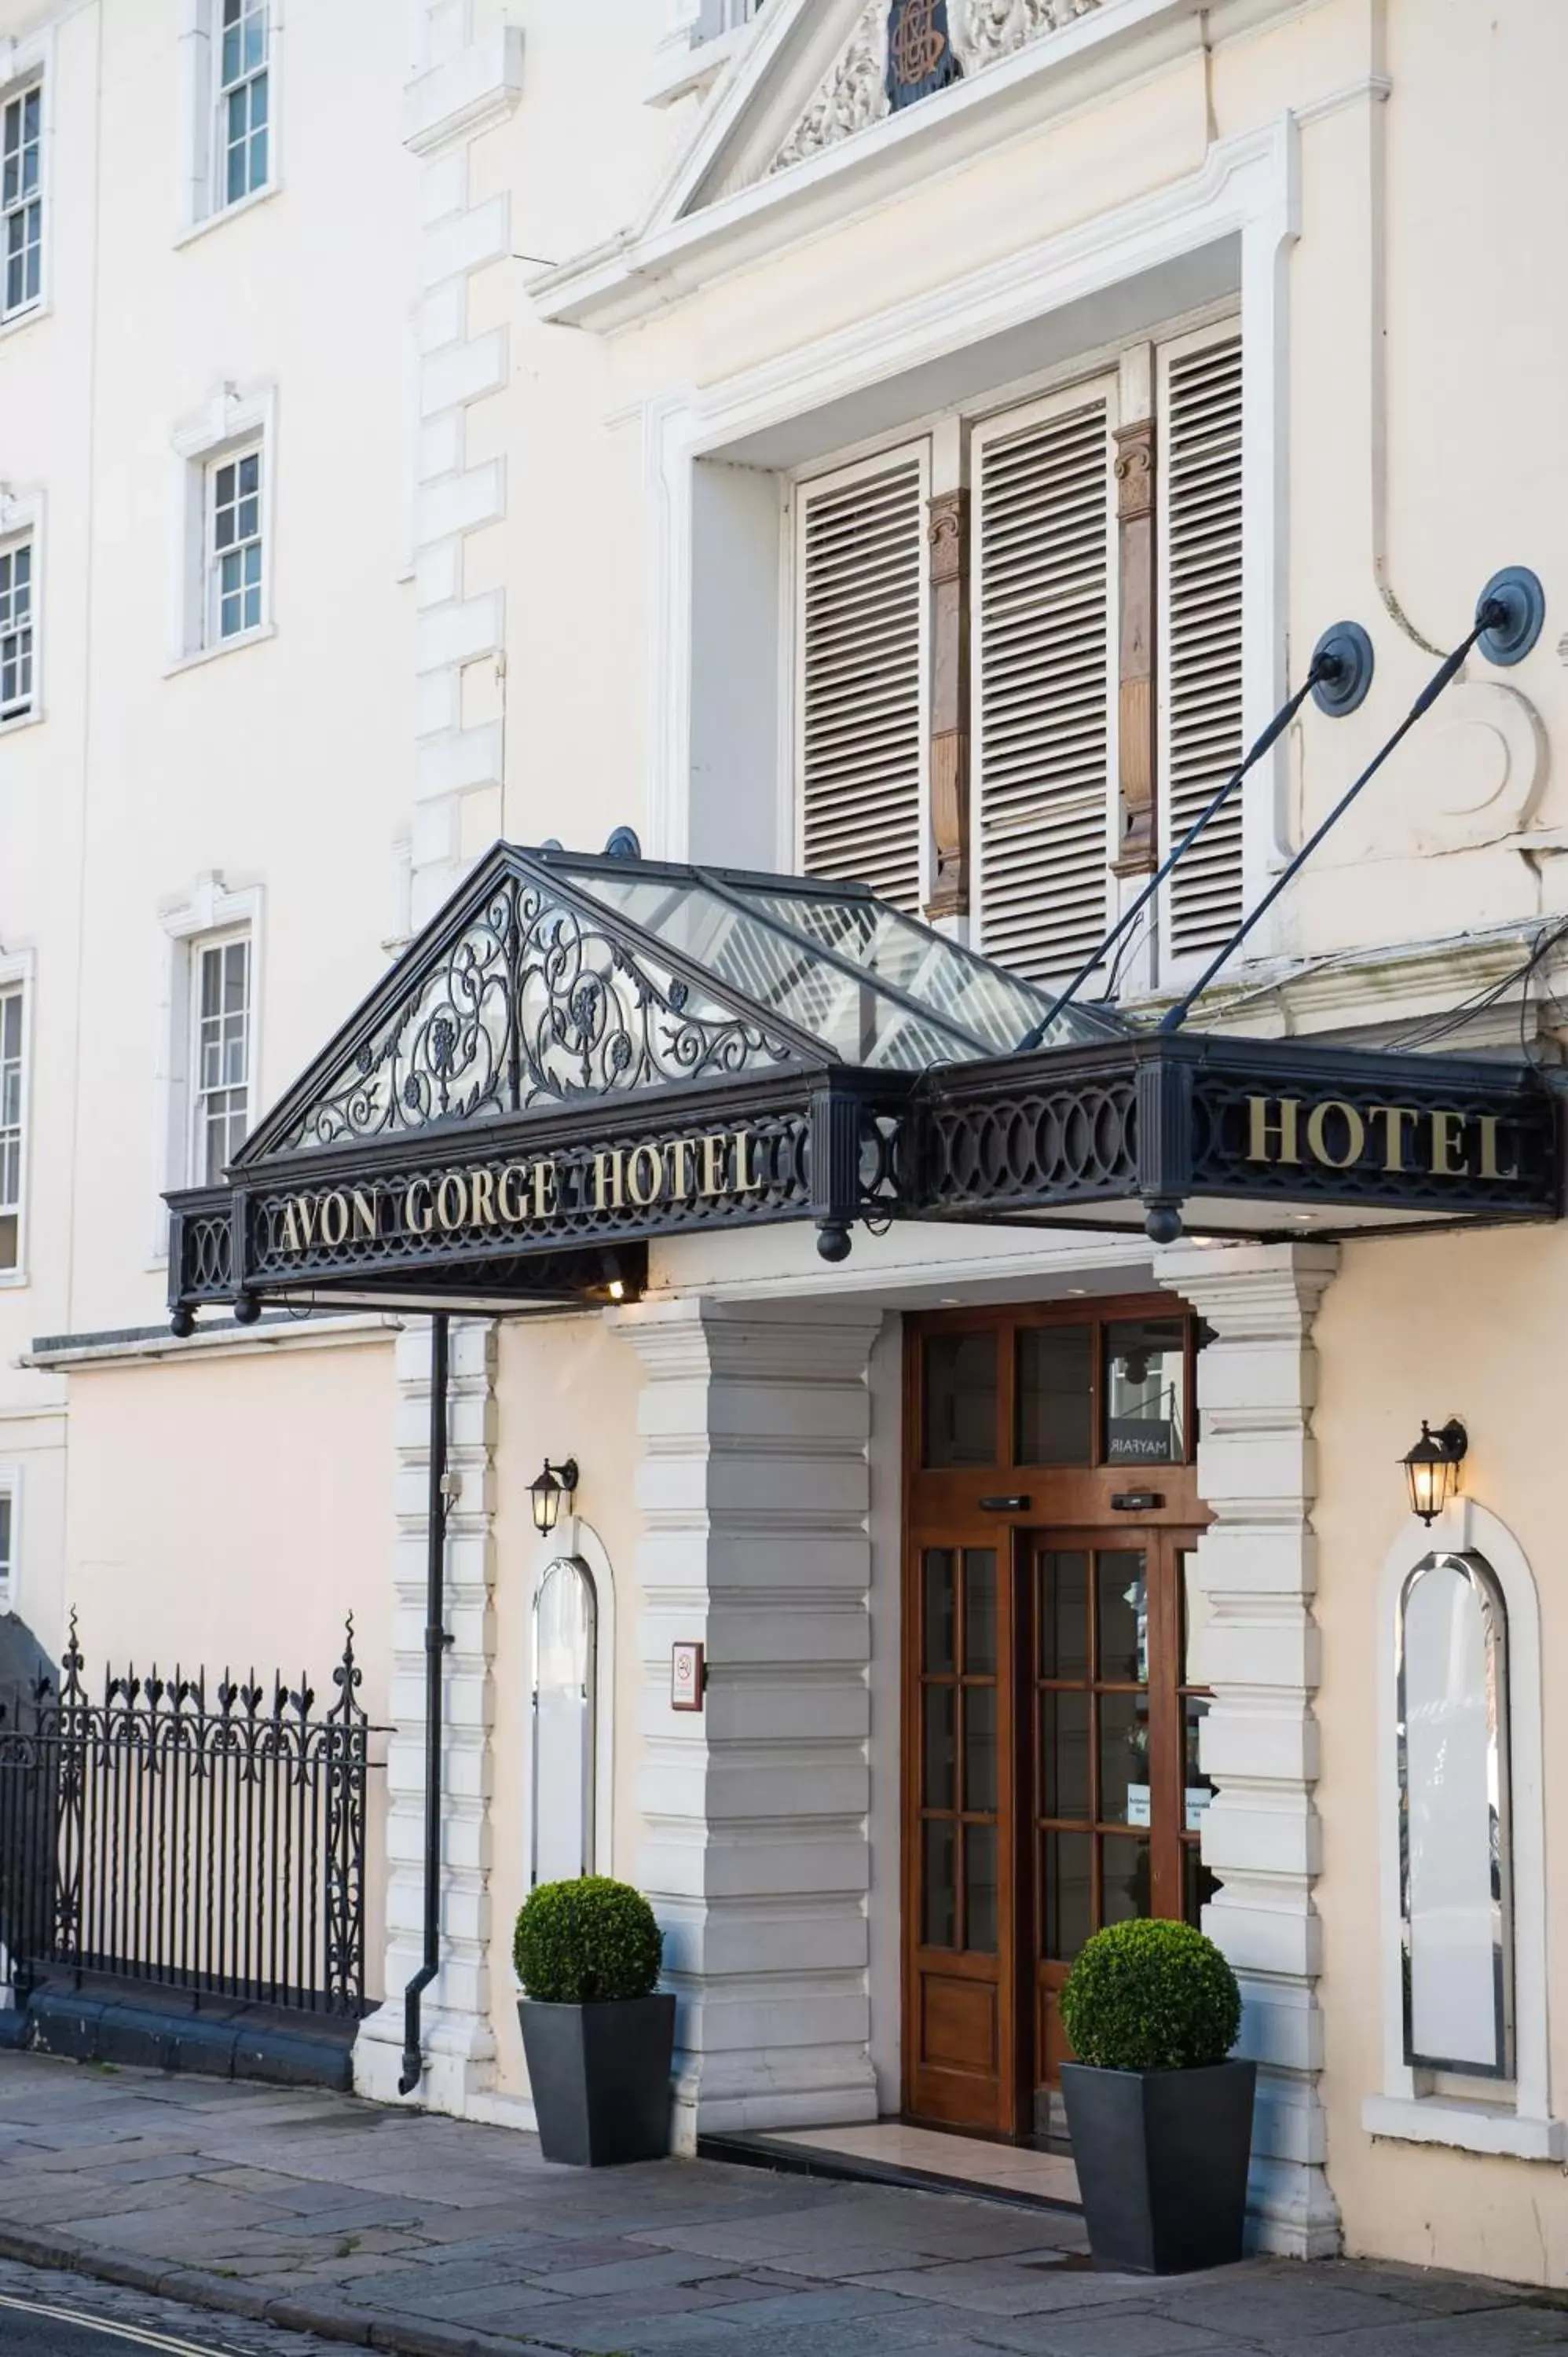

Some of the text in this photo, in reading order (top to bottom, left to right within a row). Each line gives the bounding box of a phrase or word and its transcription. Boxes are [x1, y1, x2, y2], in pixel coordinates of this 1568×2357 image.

[1246, 1096, 1518, 1178] HOTEL
[279, 1131, 762, 1252] AVON GORGE HOTEL
